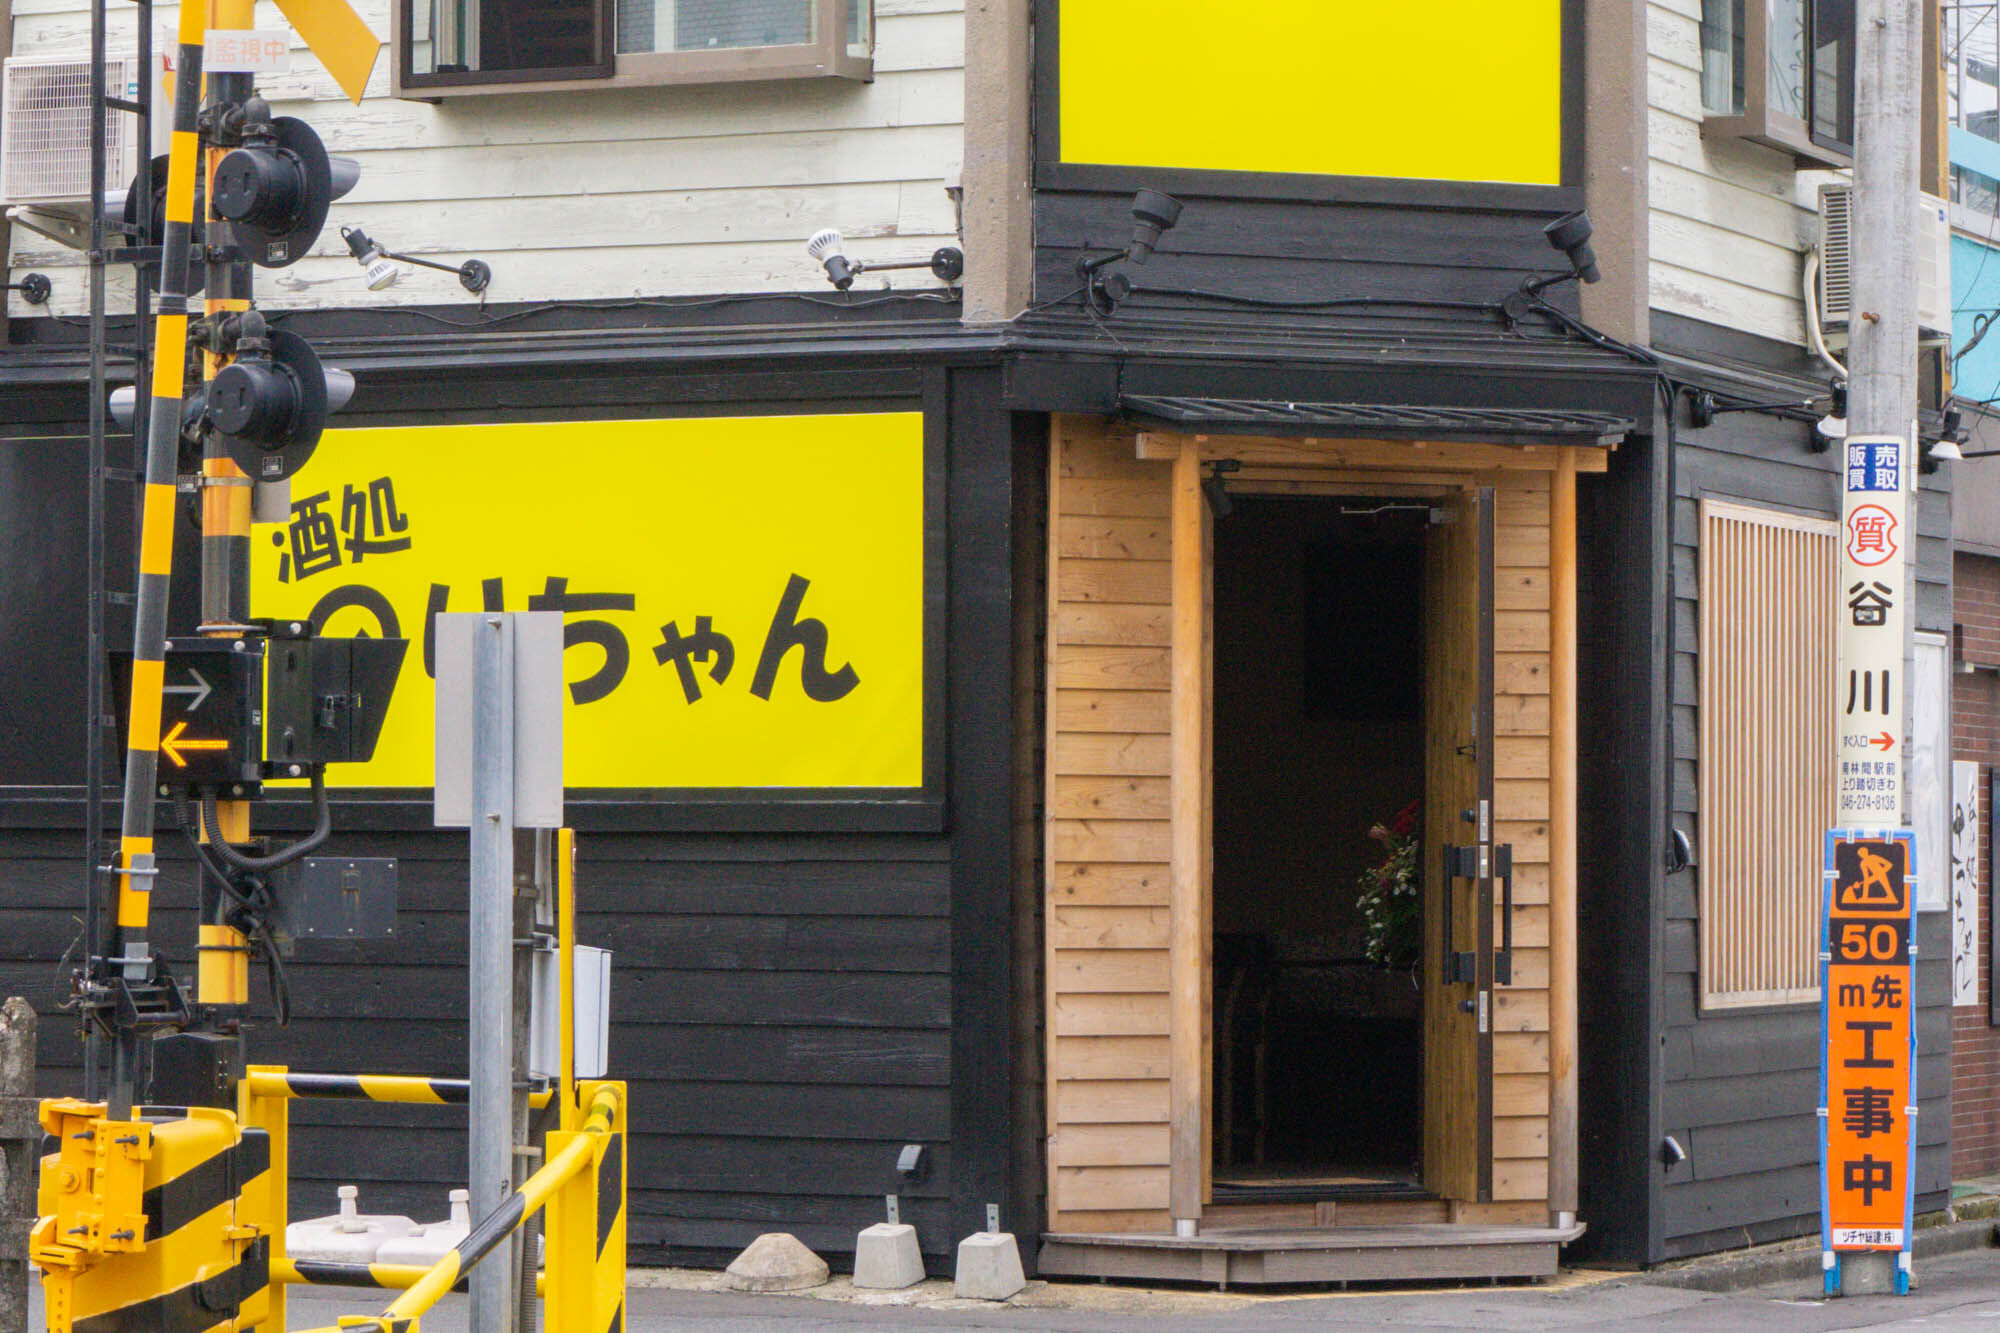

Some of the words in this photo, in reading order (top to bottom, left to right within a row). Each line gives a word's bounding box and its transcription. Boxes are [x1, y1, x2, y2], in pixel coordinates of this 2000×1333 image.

[272, 476, 412, 584] 酒処
[1855, 516, 1886, 553] 質
[1841, 794, 1896, 810] 046-274-8136
[1841, 924, 1898, 960] 50
[1843, 1021, 1894, 1206] 工事中
